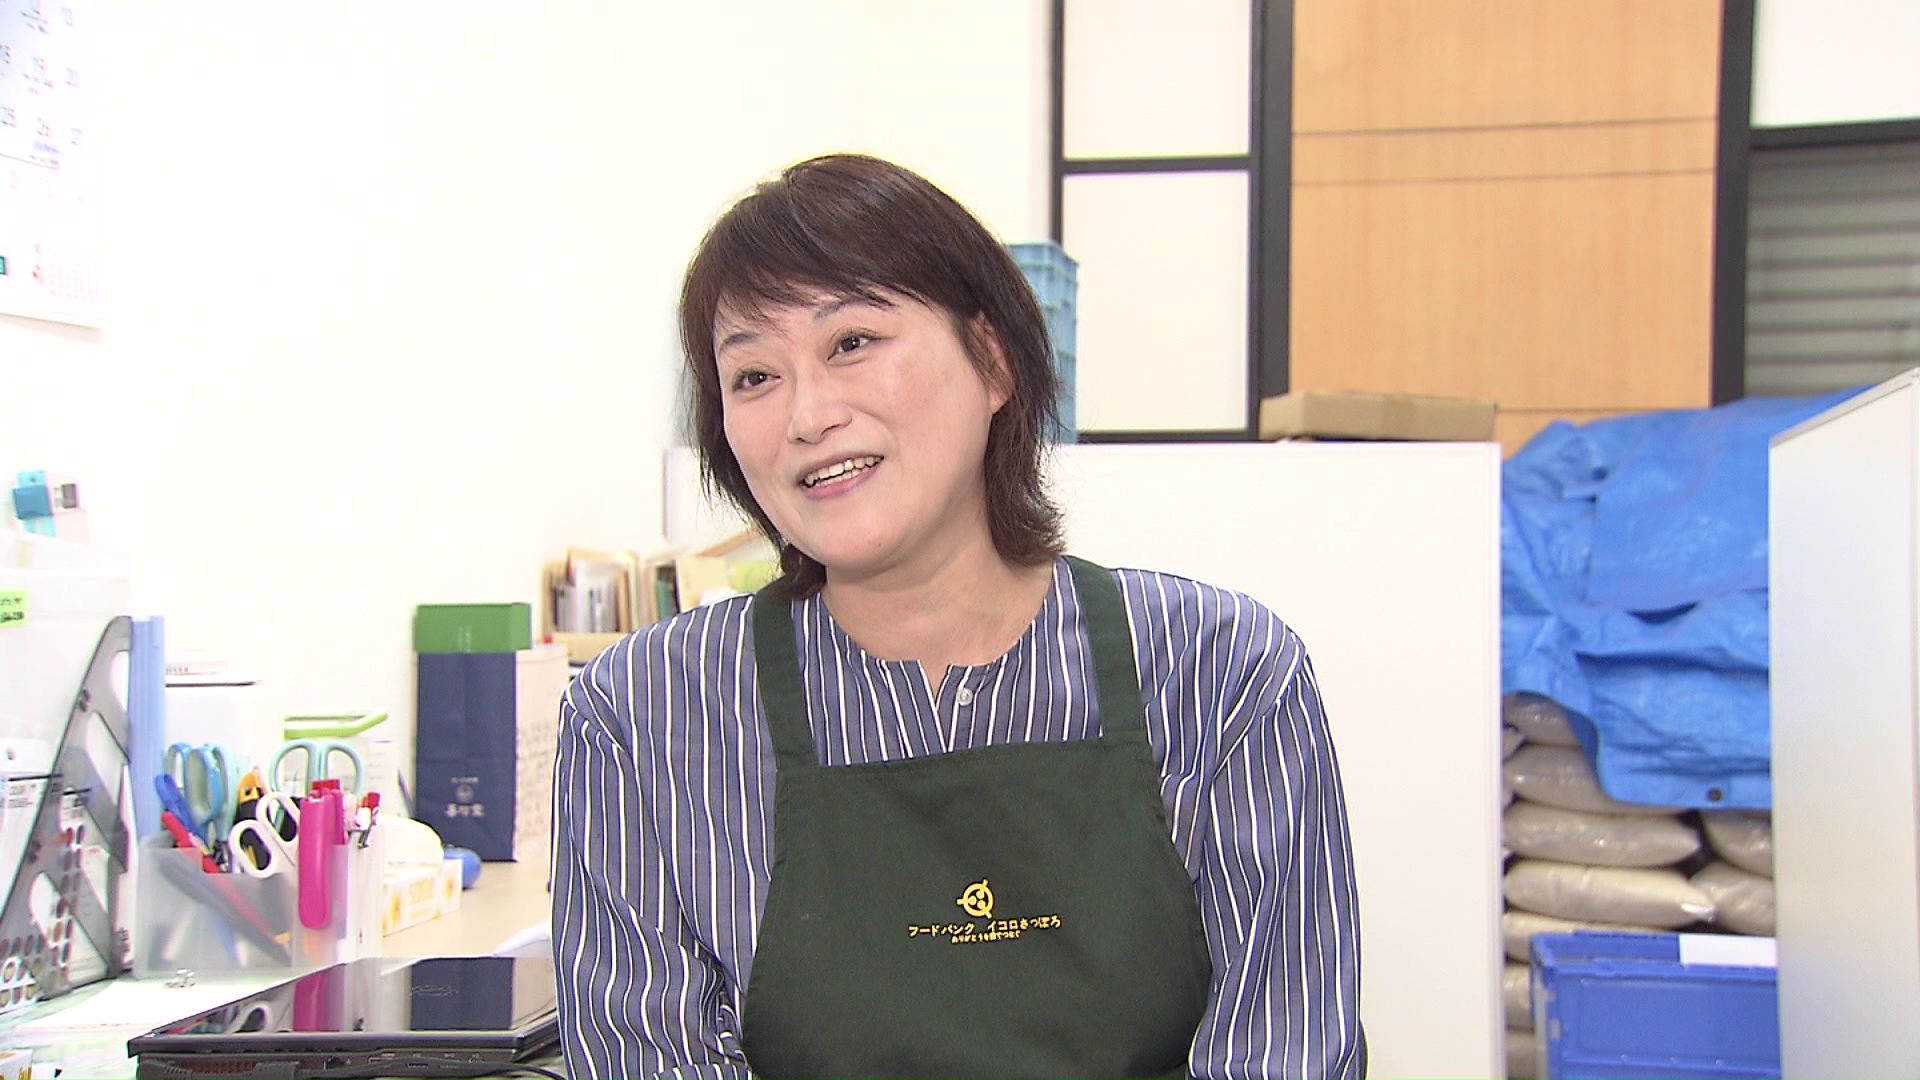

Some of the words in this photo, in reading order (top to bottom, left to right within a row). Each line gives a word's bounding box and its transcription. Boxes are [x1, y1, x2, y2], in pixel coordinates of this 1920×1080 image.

[908, 922, 975, 937] フードバンク
[987, 915, 1061, 932] イコロさっぽろ
